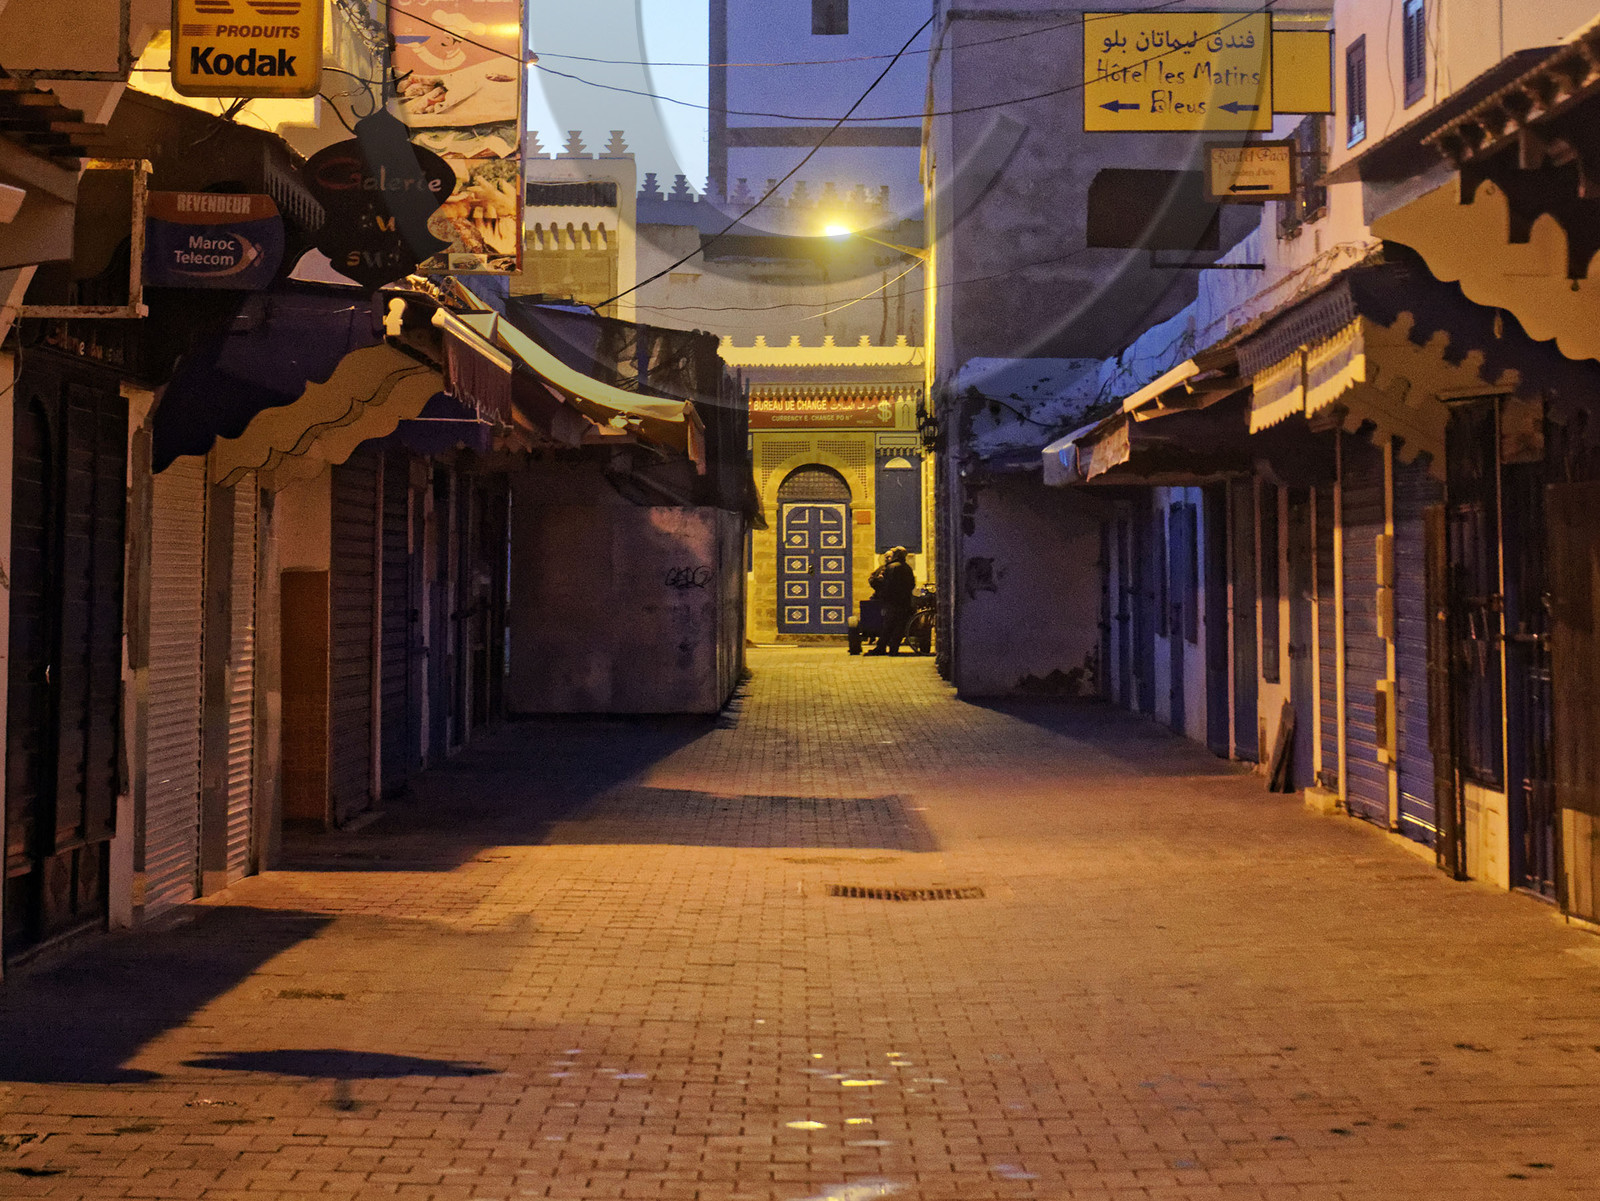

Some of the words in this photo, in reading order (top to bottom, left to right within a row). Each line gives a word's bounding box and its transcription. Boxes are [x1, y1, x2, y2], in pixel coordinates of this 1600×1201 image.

[216, 24, 300, 39] PRODUITS
[1102, 30, 1127, 53] بلو
[1207, 31, 1255, 52] فندق
[190, 46, 297, 77] Kodak
[1159, 61, 1185, 84] les
[177, 194, 251, 214] REVENDEUR
[188, 235, 235, 250] Maroc
[174, 250, 234, 266] Telecom
[754, 400, 783, 411] BUREAU
[785, 400, 794, 411] DE
[796, 399, 827, 411] CHANGE
[771, 414, 803, 422] CURRENCY
